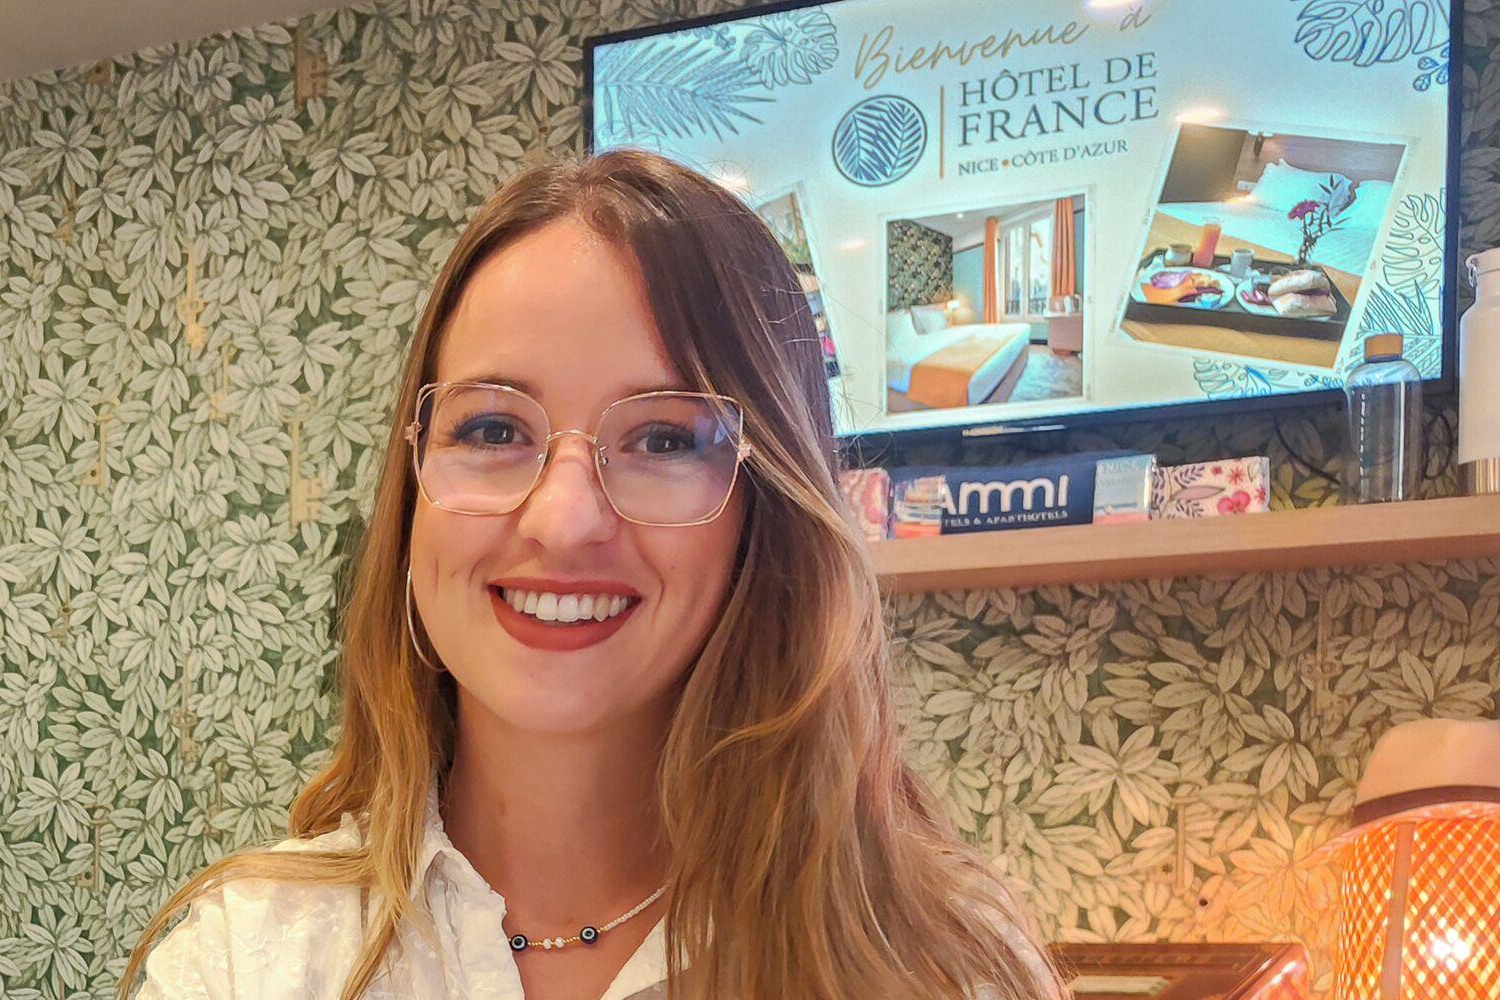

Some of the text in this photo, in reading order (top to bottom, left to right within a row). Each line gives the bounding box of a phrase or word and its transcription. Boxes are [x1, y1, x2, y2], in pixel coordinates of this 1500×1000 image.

[853, 5, 1152, 90] Bienvenue à
[959, 51, 1158, 108] HÔTEL DE
[957, 86, 1160, 147] FRANCE
[957, 139, 1130, 177] NICE CÔTE D'AZUR
